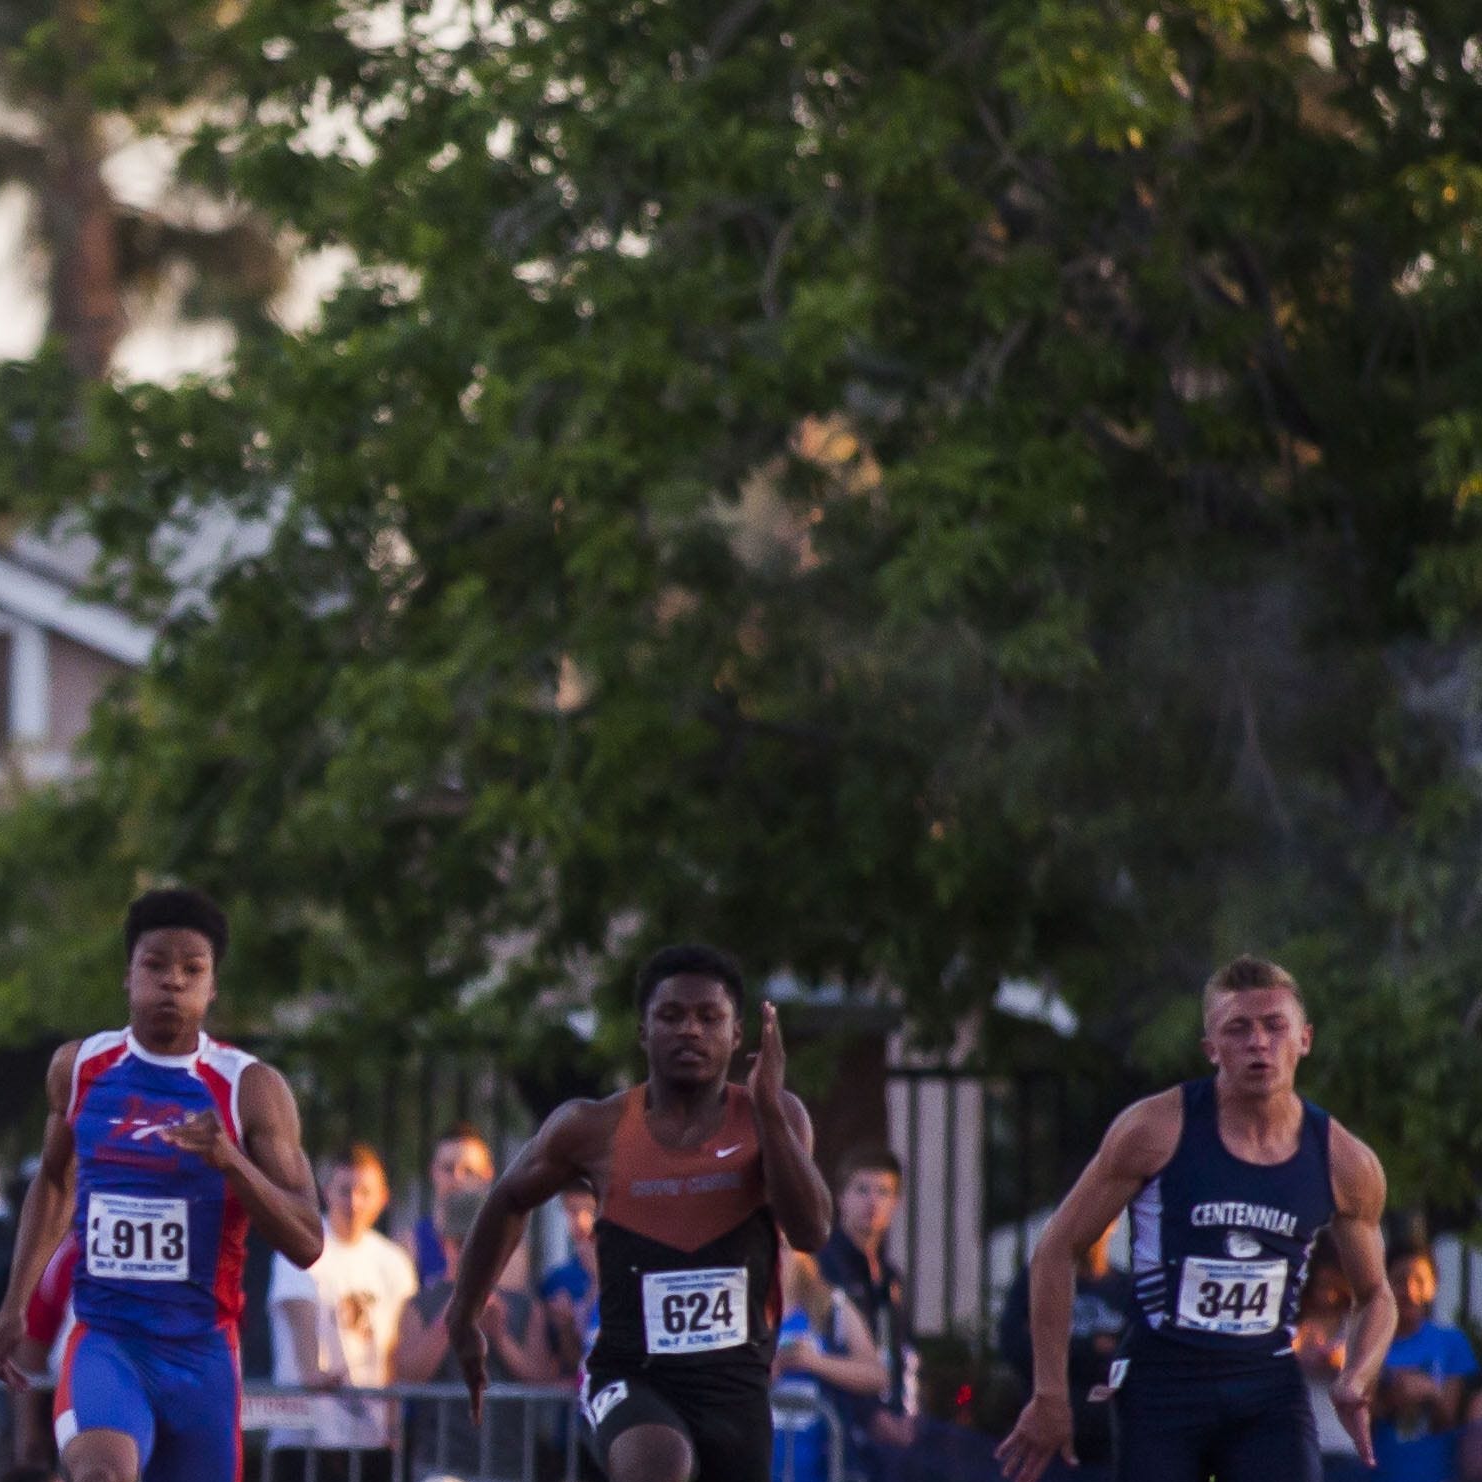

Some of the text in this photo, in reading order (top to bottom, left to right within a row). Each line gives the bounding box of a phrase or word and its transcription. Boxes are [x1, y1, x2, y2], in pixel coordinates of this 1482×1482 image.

[1191, 1202, 1298, 1237] CENTENNIAL
[1196, 1271, 1269, 1310] 344
[662, 1289, 734, 1335] 624
